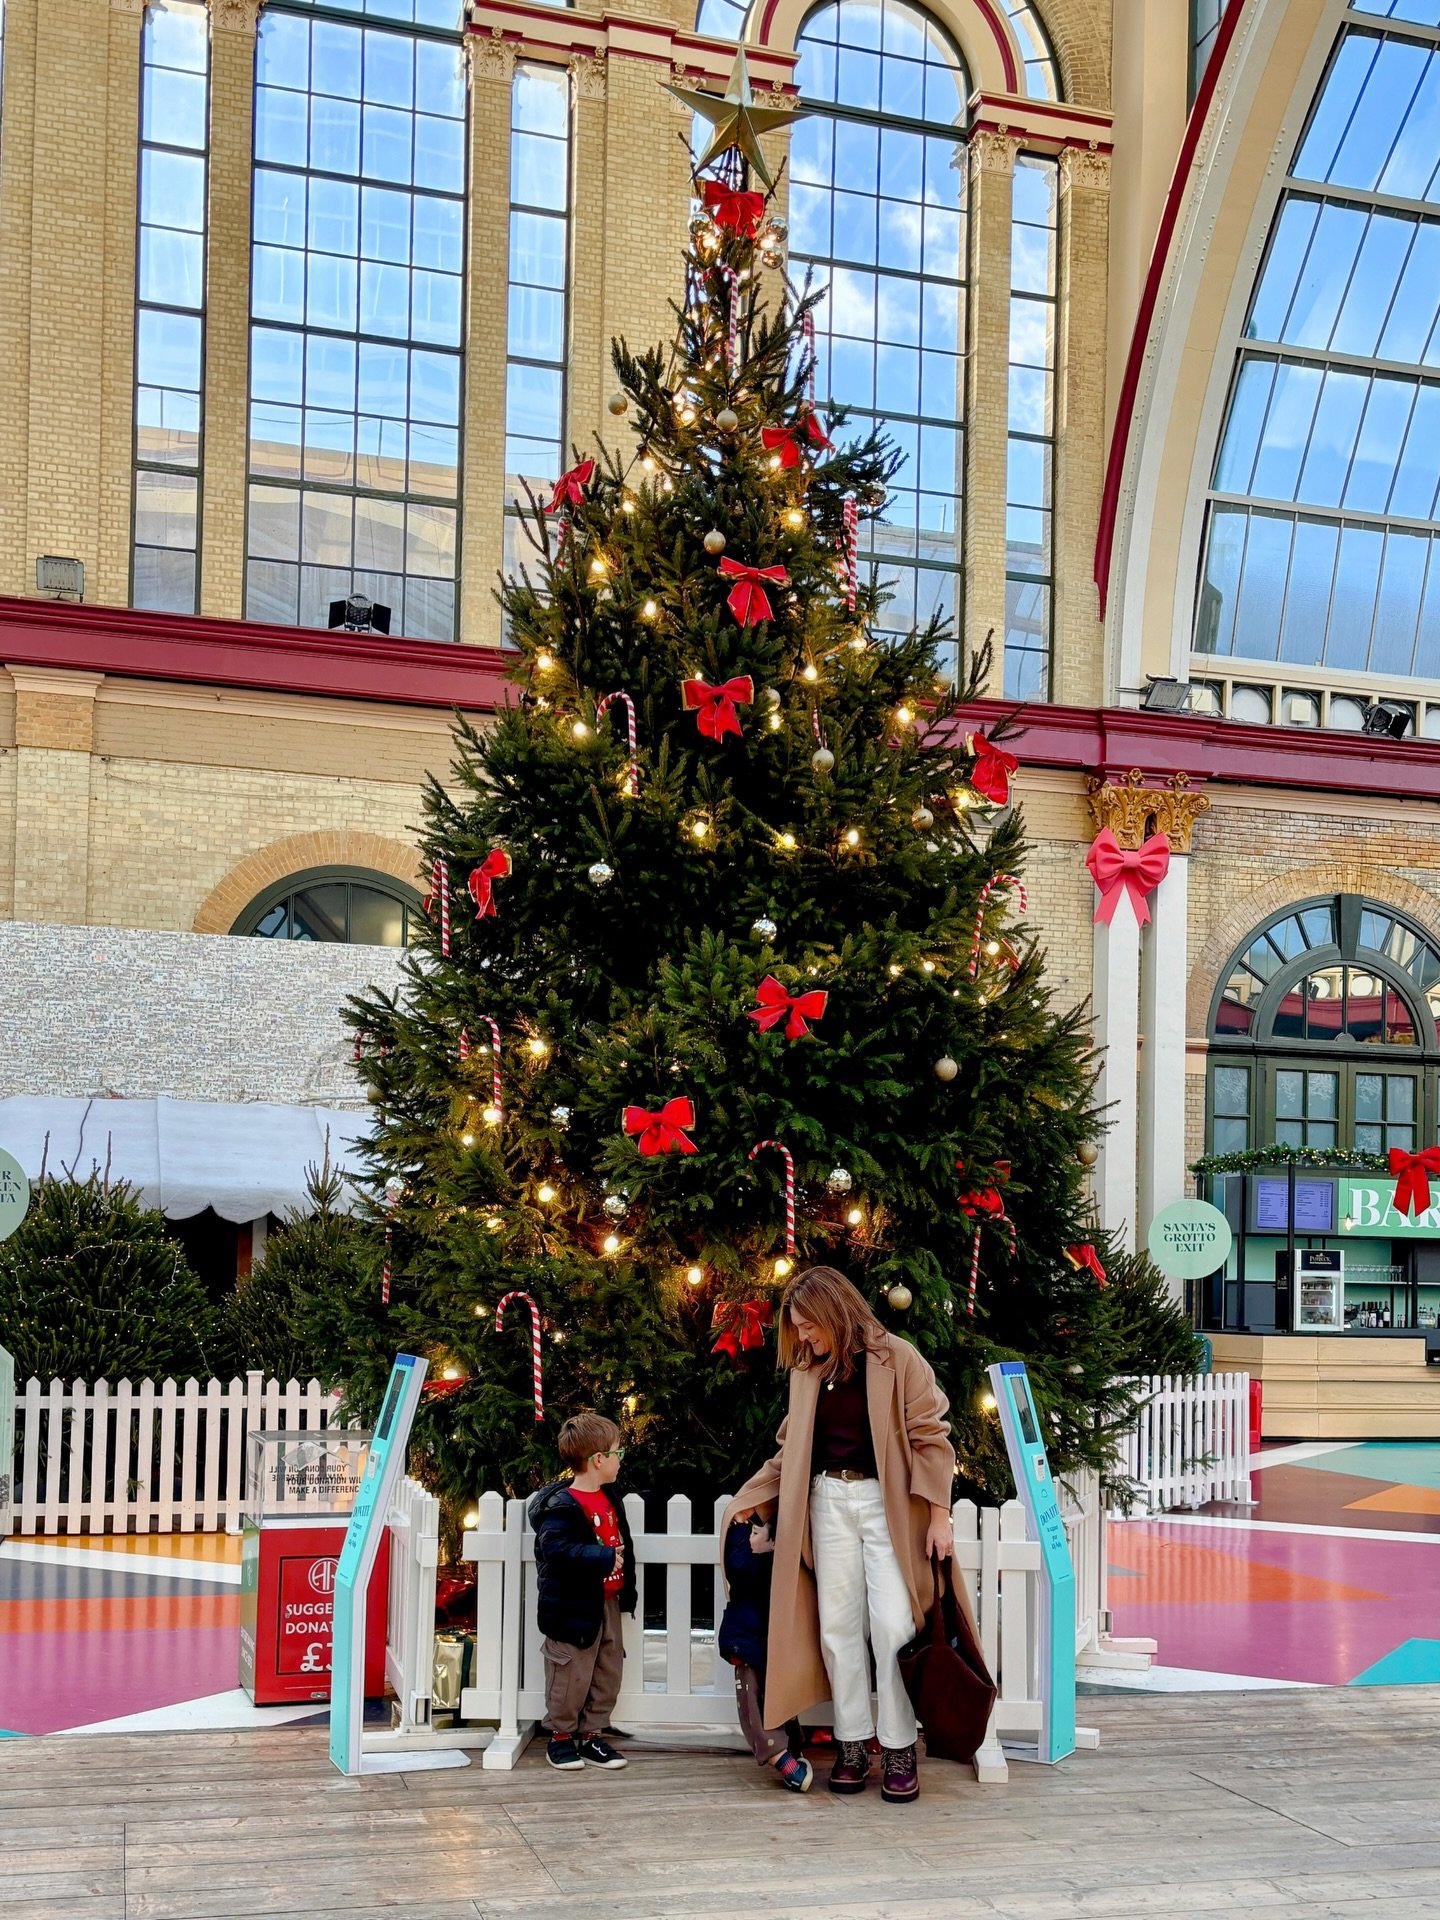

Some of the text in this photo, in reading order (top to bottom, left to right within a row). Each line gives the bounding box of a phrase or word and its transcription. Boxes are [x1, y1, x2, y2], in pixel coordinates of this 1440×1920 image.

[1163, 1223, 1216, 1232] SANTA'S
[1164, 1233, 1216, 1242] GROTTO
[1176, 1243, 1204, 1252] EXIT
[286, 1477, 306, 1485] YOUR
[309, 1476, 346, 1484] DONATION
[349, 1476, 362, 1484] WIL
[289, 1486, 310, 1494] MAKE
[286, 1603, 333, 1616] SUGGE
[285, 1621, 334, 1635] DONAT
